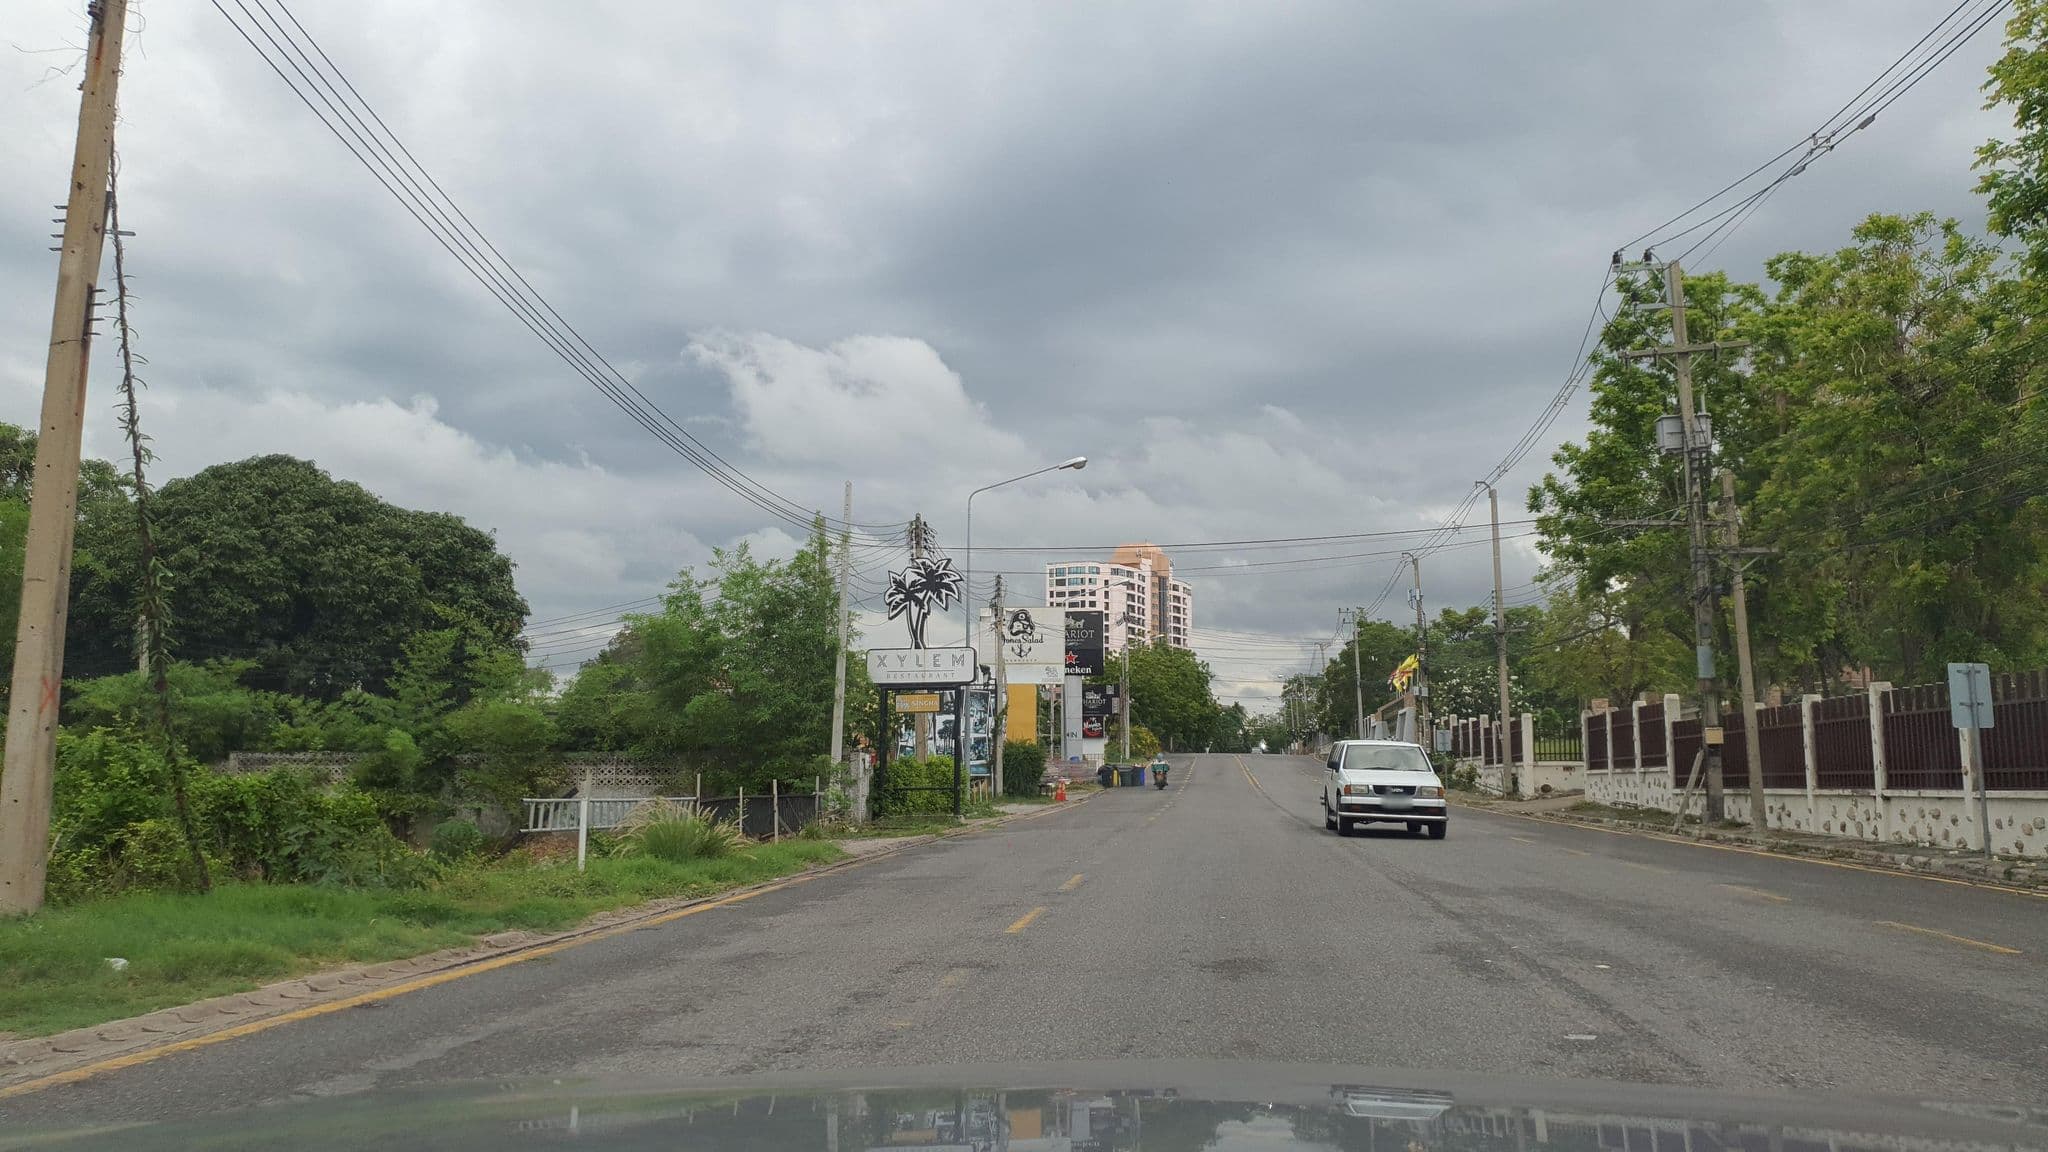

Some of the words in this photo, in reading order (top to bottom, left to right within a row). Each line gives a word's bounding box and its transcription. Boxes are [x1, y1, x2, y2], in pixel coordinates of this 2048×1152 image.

[1022, 633, 1044, 644] Salad
[1065, 629, 1095, 639] ARIOT
[877, 653, 965, 668] XYLEM
[1065, 665, 1092, 674] neken
[886, 672, 955, 680] RESTAURANT
[911, 700, 939, 708] SINGHA
